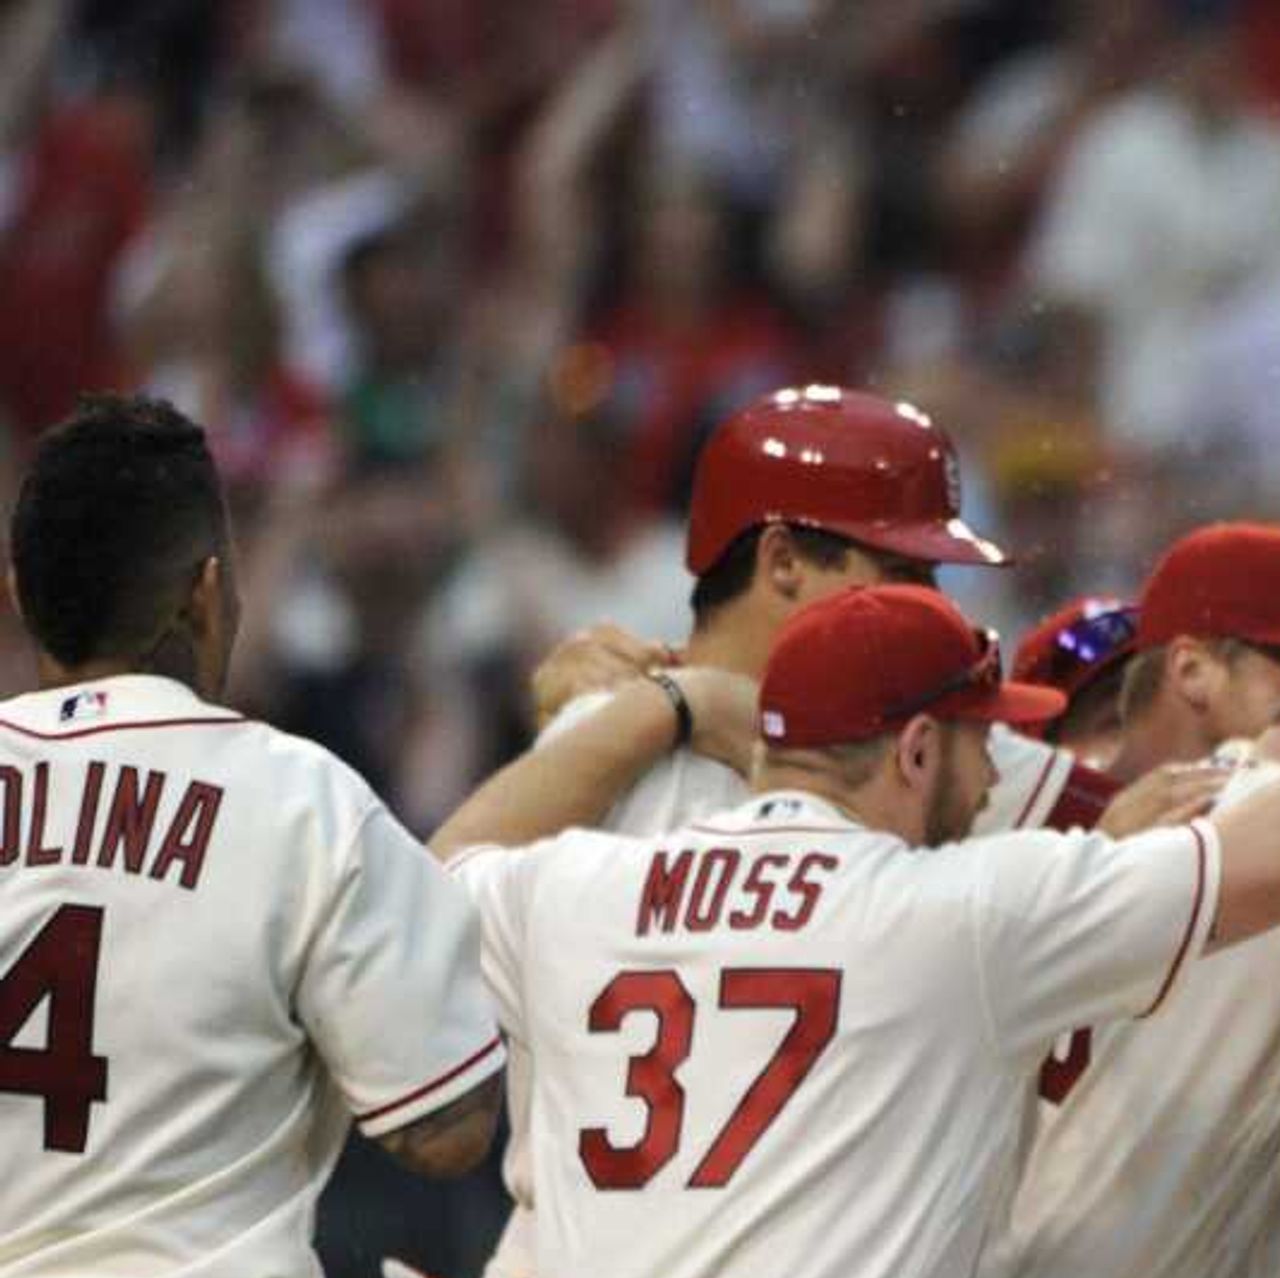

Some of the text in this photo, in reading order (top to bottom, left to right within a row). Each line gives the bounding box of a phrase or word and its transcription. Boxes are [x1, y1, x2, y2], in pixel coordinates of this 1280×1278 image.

[635, 847, 839, 937] MOSS
[0, 903, 109, 1153] 4
[578, 967, 843, 1191] 37
